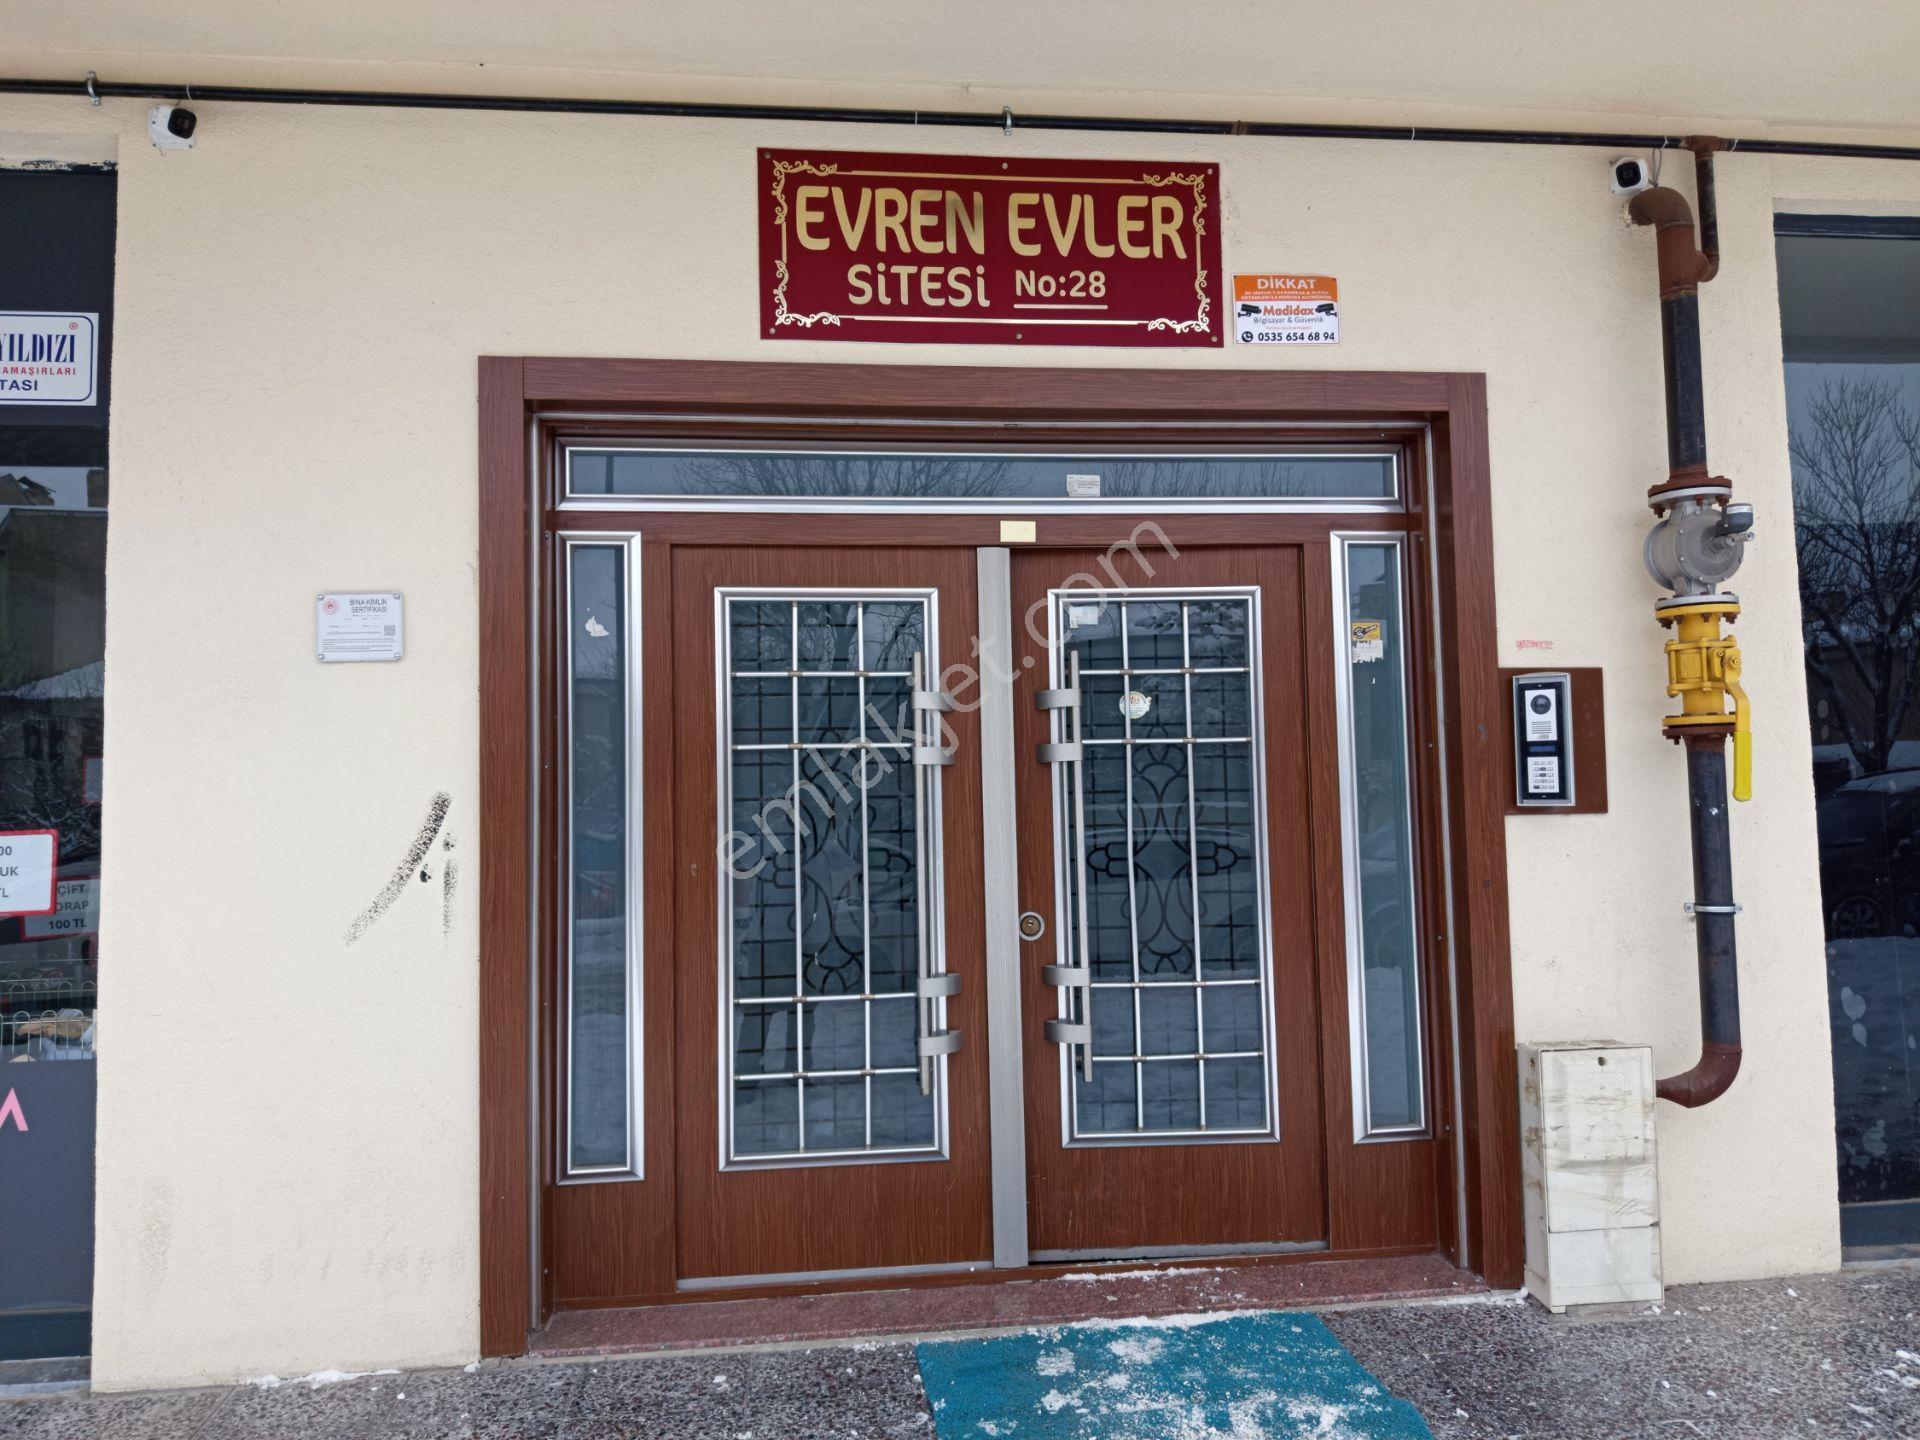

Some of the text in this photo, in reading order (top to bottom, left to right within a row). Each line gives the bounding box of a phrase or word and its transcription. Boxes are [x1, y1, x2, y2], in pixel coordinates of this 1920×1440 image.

[796, 186, 1187, 259] EVREN EVLER
[1015, 270, 1107, 298] No:28
[1257, 276, 1316, 289] DİKKAT
[1253, 317, 1285, 325] Bilgisayar
[1258, 332, 1335, 341] 0535 654 68 94
[48, 918, 88, 930] 100 TL
